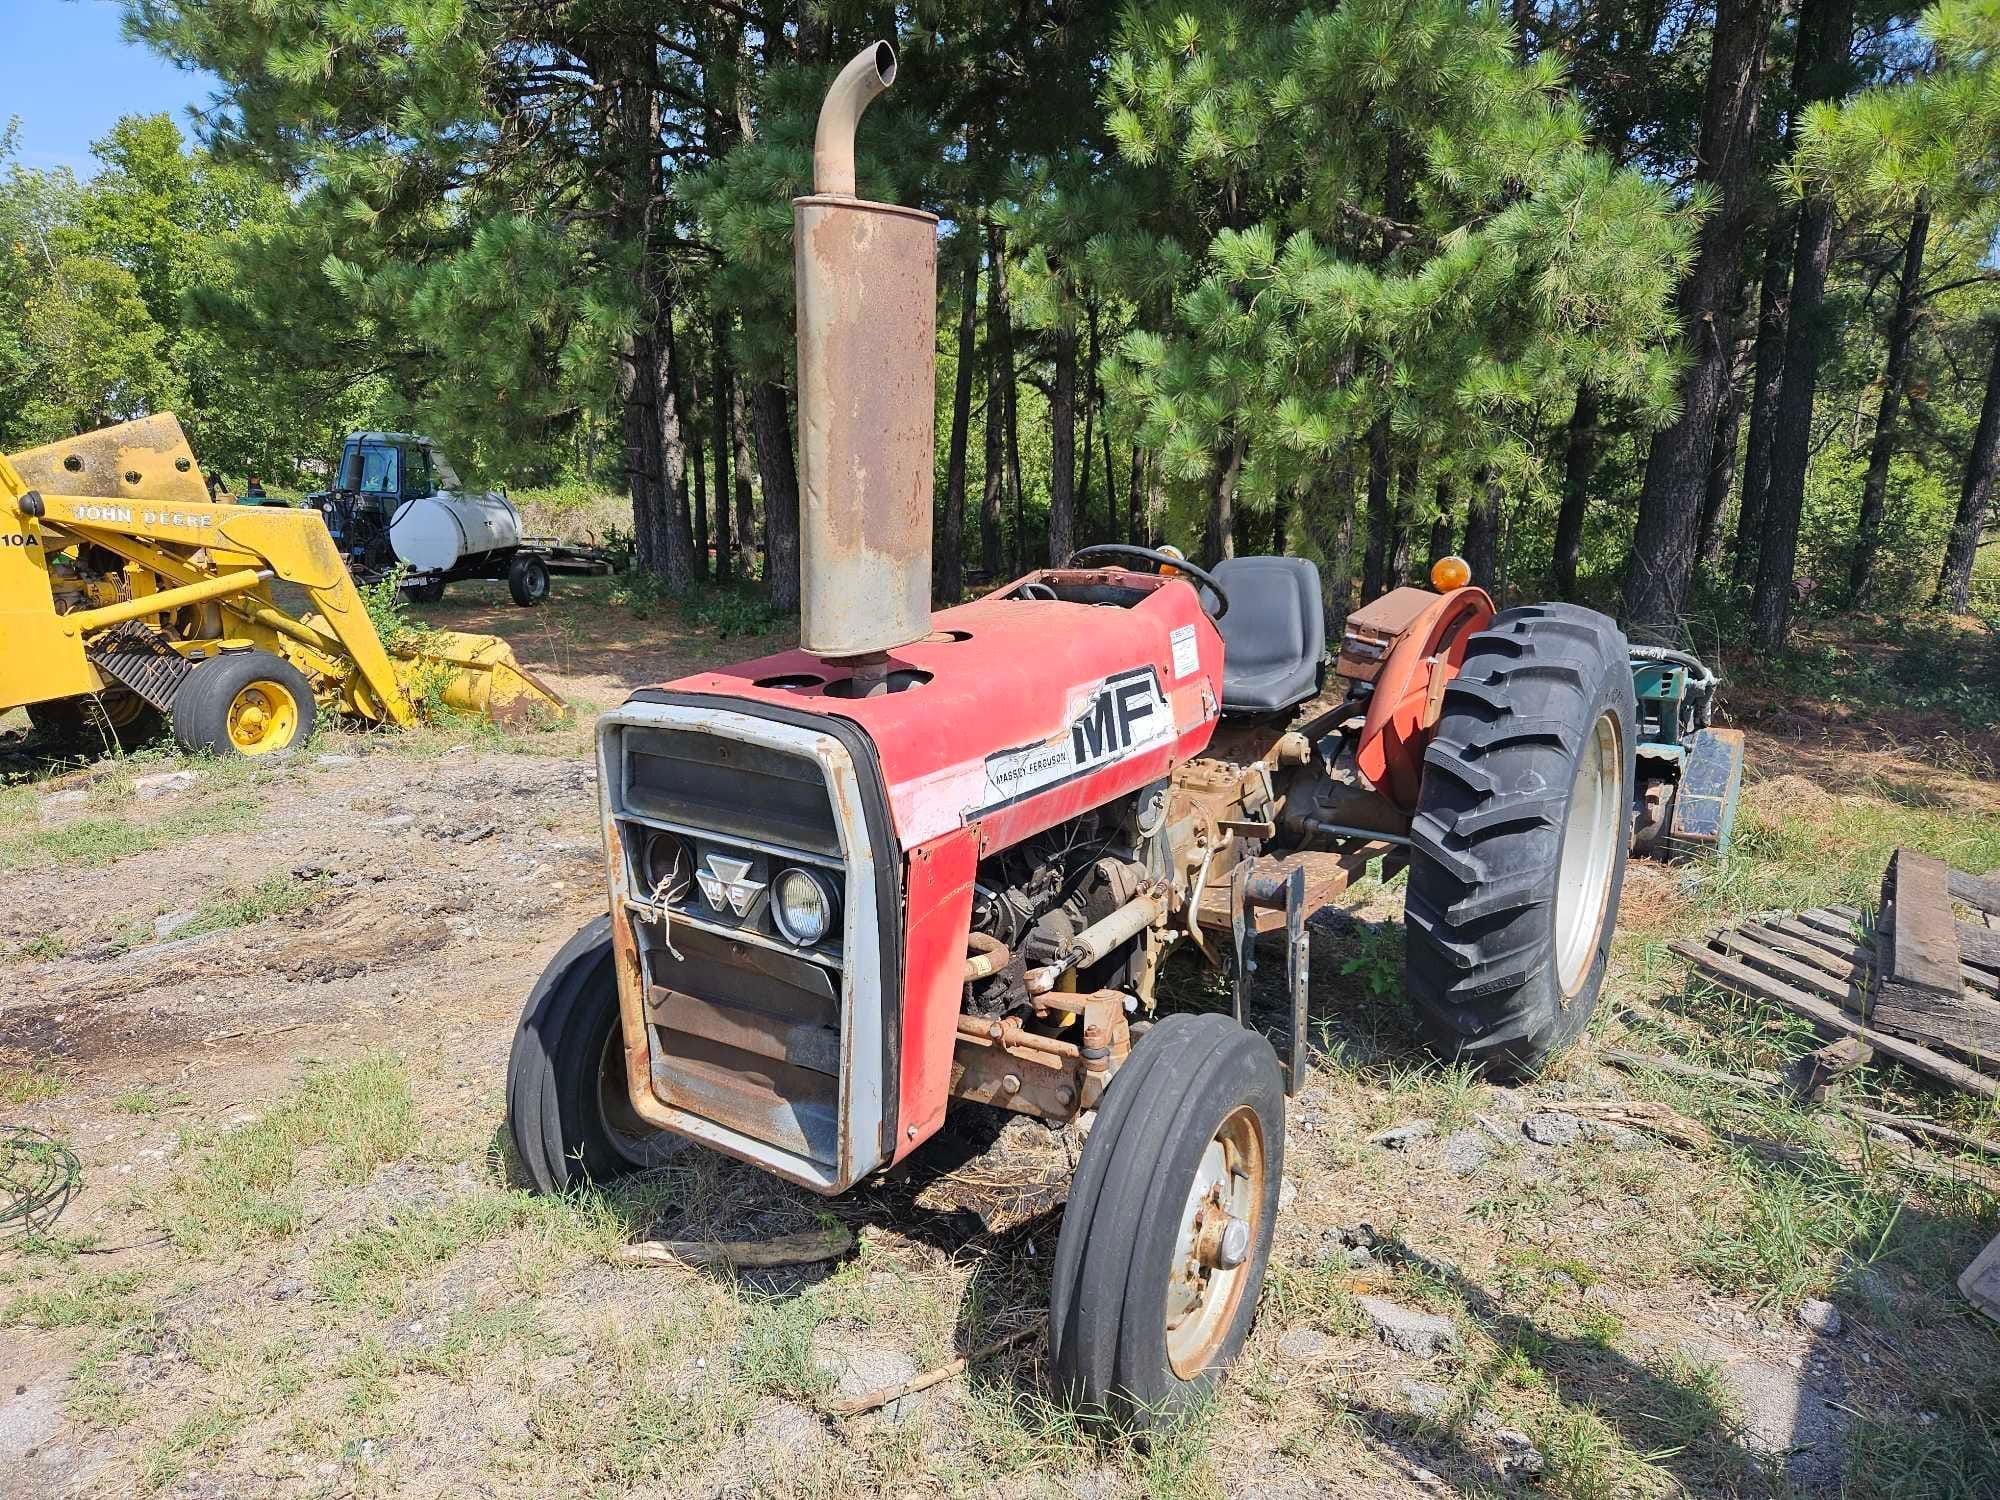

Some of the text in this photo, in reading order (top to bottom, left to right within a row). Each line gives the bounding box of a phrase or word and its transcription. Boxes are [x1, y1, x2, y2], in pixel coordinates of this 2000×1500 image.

[75, 506, 214, 529] JOHN DEERE
[1072, 679, 1153, 765] MF
[996, 752, 1067, 785] MASSEY FERGUSON
[706, 881, 745, 900] MF
